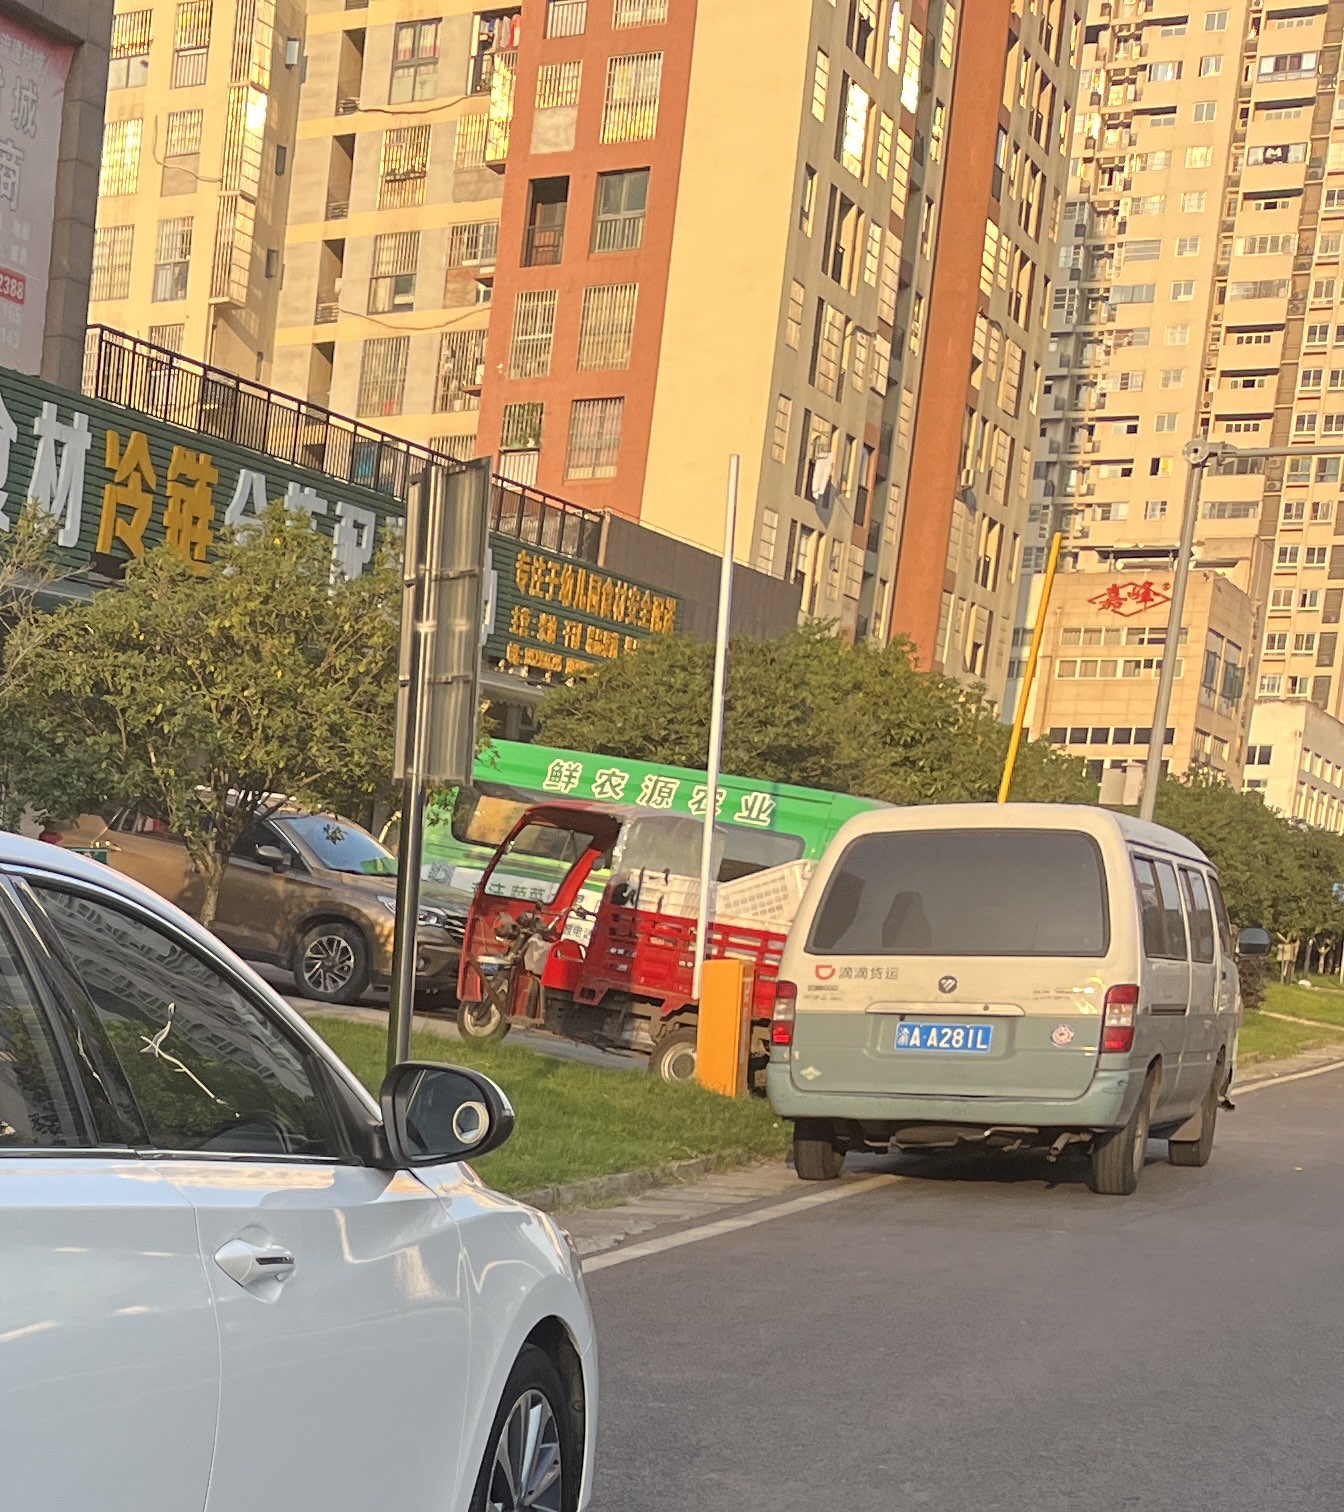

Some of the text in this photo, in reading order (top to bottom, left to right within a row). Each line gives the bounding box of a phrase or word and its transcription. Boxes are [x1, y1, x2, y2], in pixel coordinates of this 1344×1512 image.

[543, 759, 776, 827] 鲜农源农业
[839, 966, 899, 980] 滴滴货运
